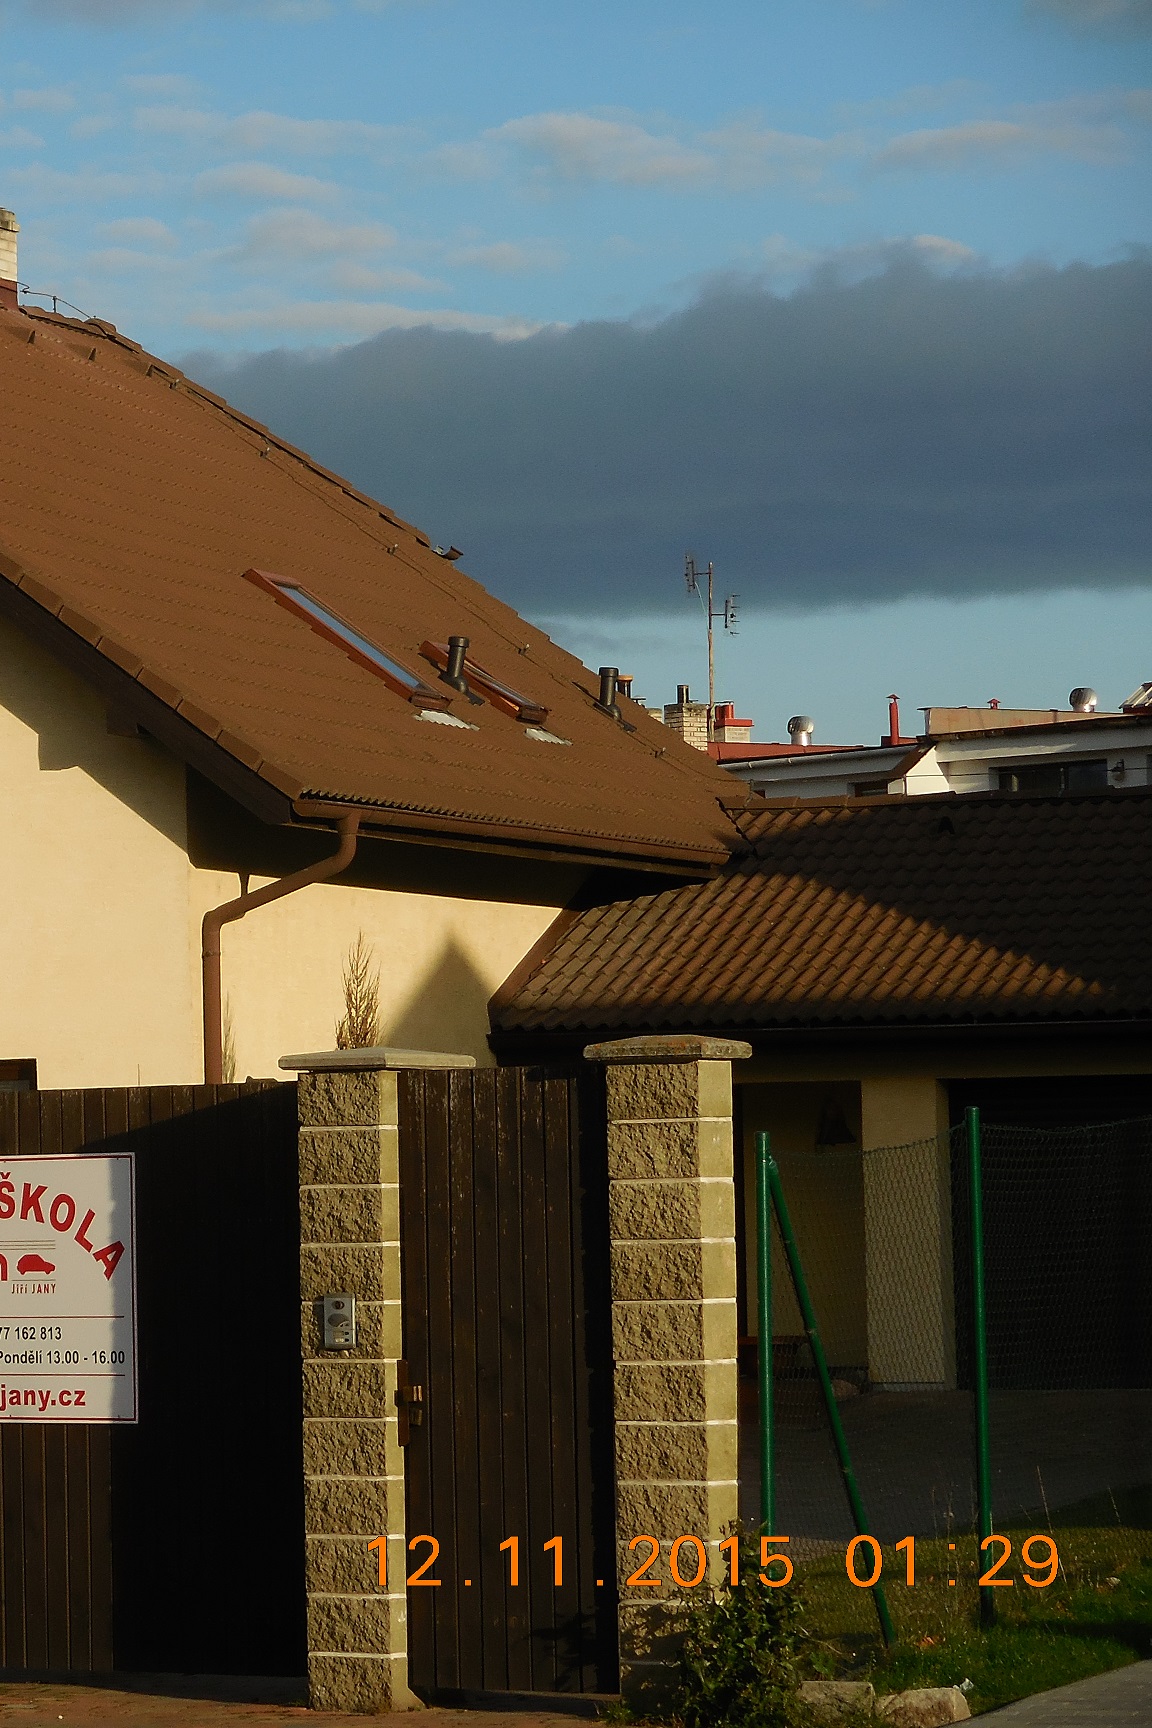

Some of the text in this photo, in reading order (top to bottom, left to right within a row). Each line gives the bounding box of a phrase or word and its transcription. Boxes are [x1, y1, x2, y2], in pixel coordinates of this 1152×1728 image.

[31, 1283, 56, 1294] JANY
[15, 1327, 36, 1340] 162
[40, 1326, 62, 1340] 813
[47, 1350, 79, 1364] 13.00
[92, 1350, 125, 1364] 16.00
